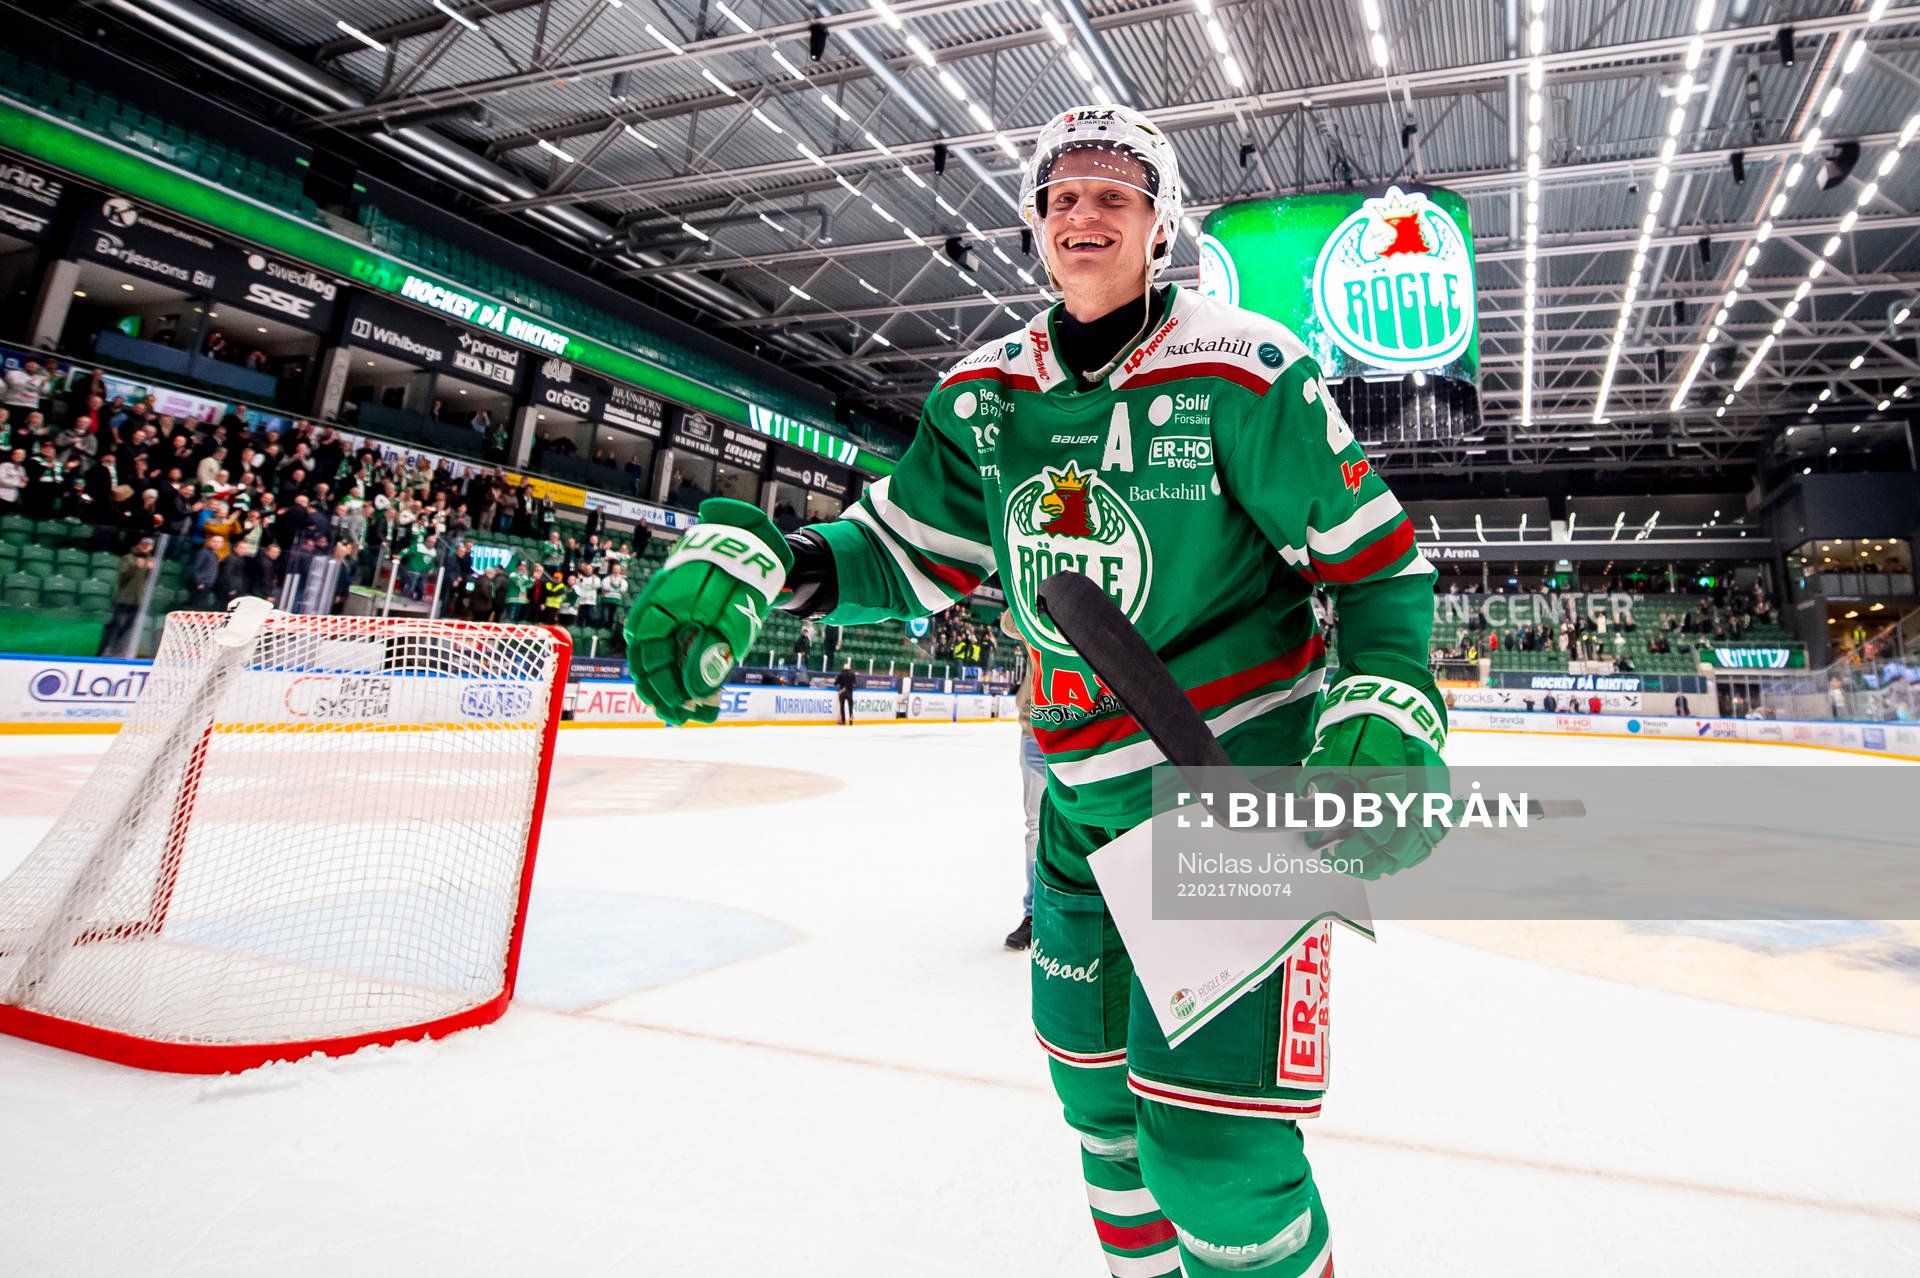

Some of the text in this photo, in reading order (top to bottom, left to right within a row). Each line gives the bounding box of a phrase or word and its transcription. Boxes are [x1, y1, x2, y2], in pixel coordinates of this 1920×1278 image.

[244, 282, 317, 319] SSE
[1342, 268, 1462, 350] RÖGLE
[401, 275, 569, 355] HOCKEY PÅ RIKTIGT
[372, 325, 443, 362] Wihlborgs
[470, 339, 519, 366] prenad
[545, 388, 591, 414] areco
[1050, 434, 1099, 444] BAUER
[1100, 401, 1134, 473] A
[1167, 458, 1197, 469] BYGG
[812, 471, 828, 489] EY
[1129, 482, 1206, 502] Backahill
[1443, 548, 1480, 559] Arena
[1482, 594, 1634, 628] CENTER
[1531, 676, 1576, 691] HOCKEY
[1576, 675, 1594, 690] PÅ
[313, 697, 390, 718] SYSTEM
[775, 695, 833, 714] NORRVIDINGE
[1198, 979, 1223, 998] RÖGLE
[1219, 968, 1231, 983] BK
